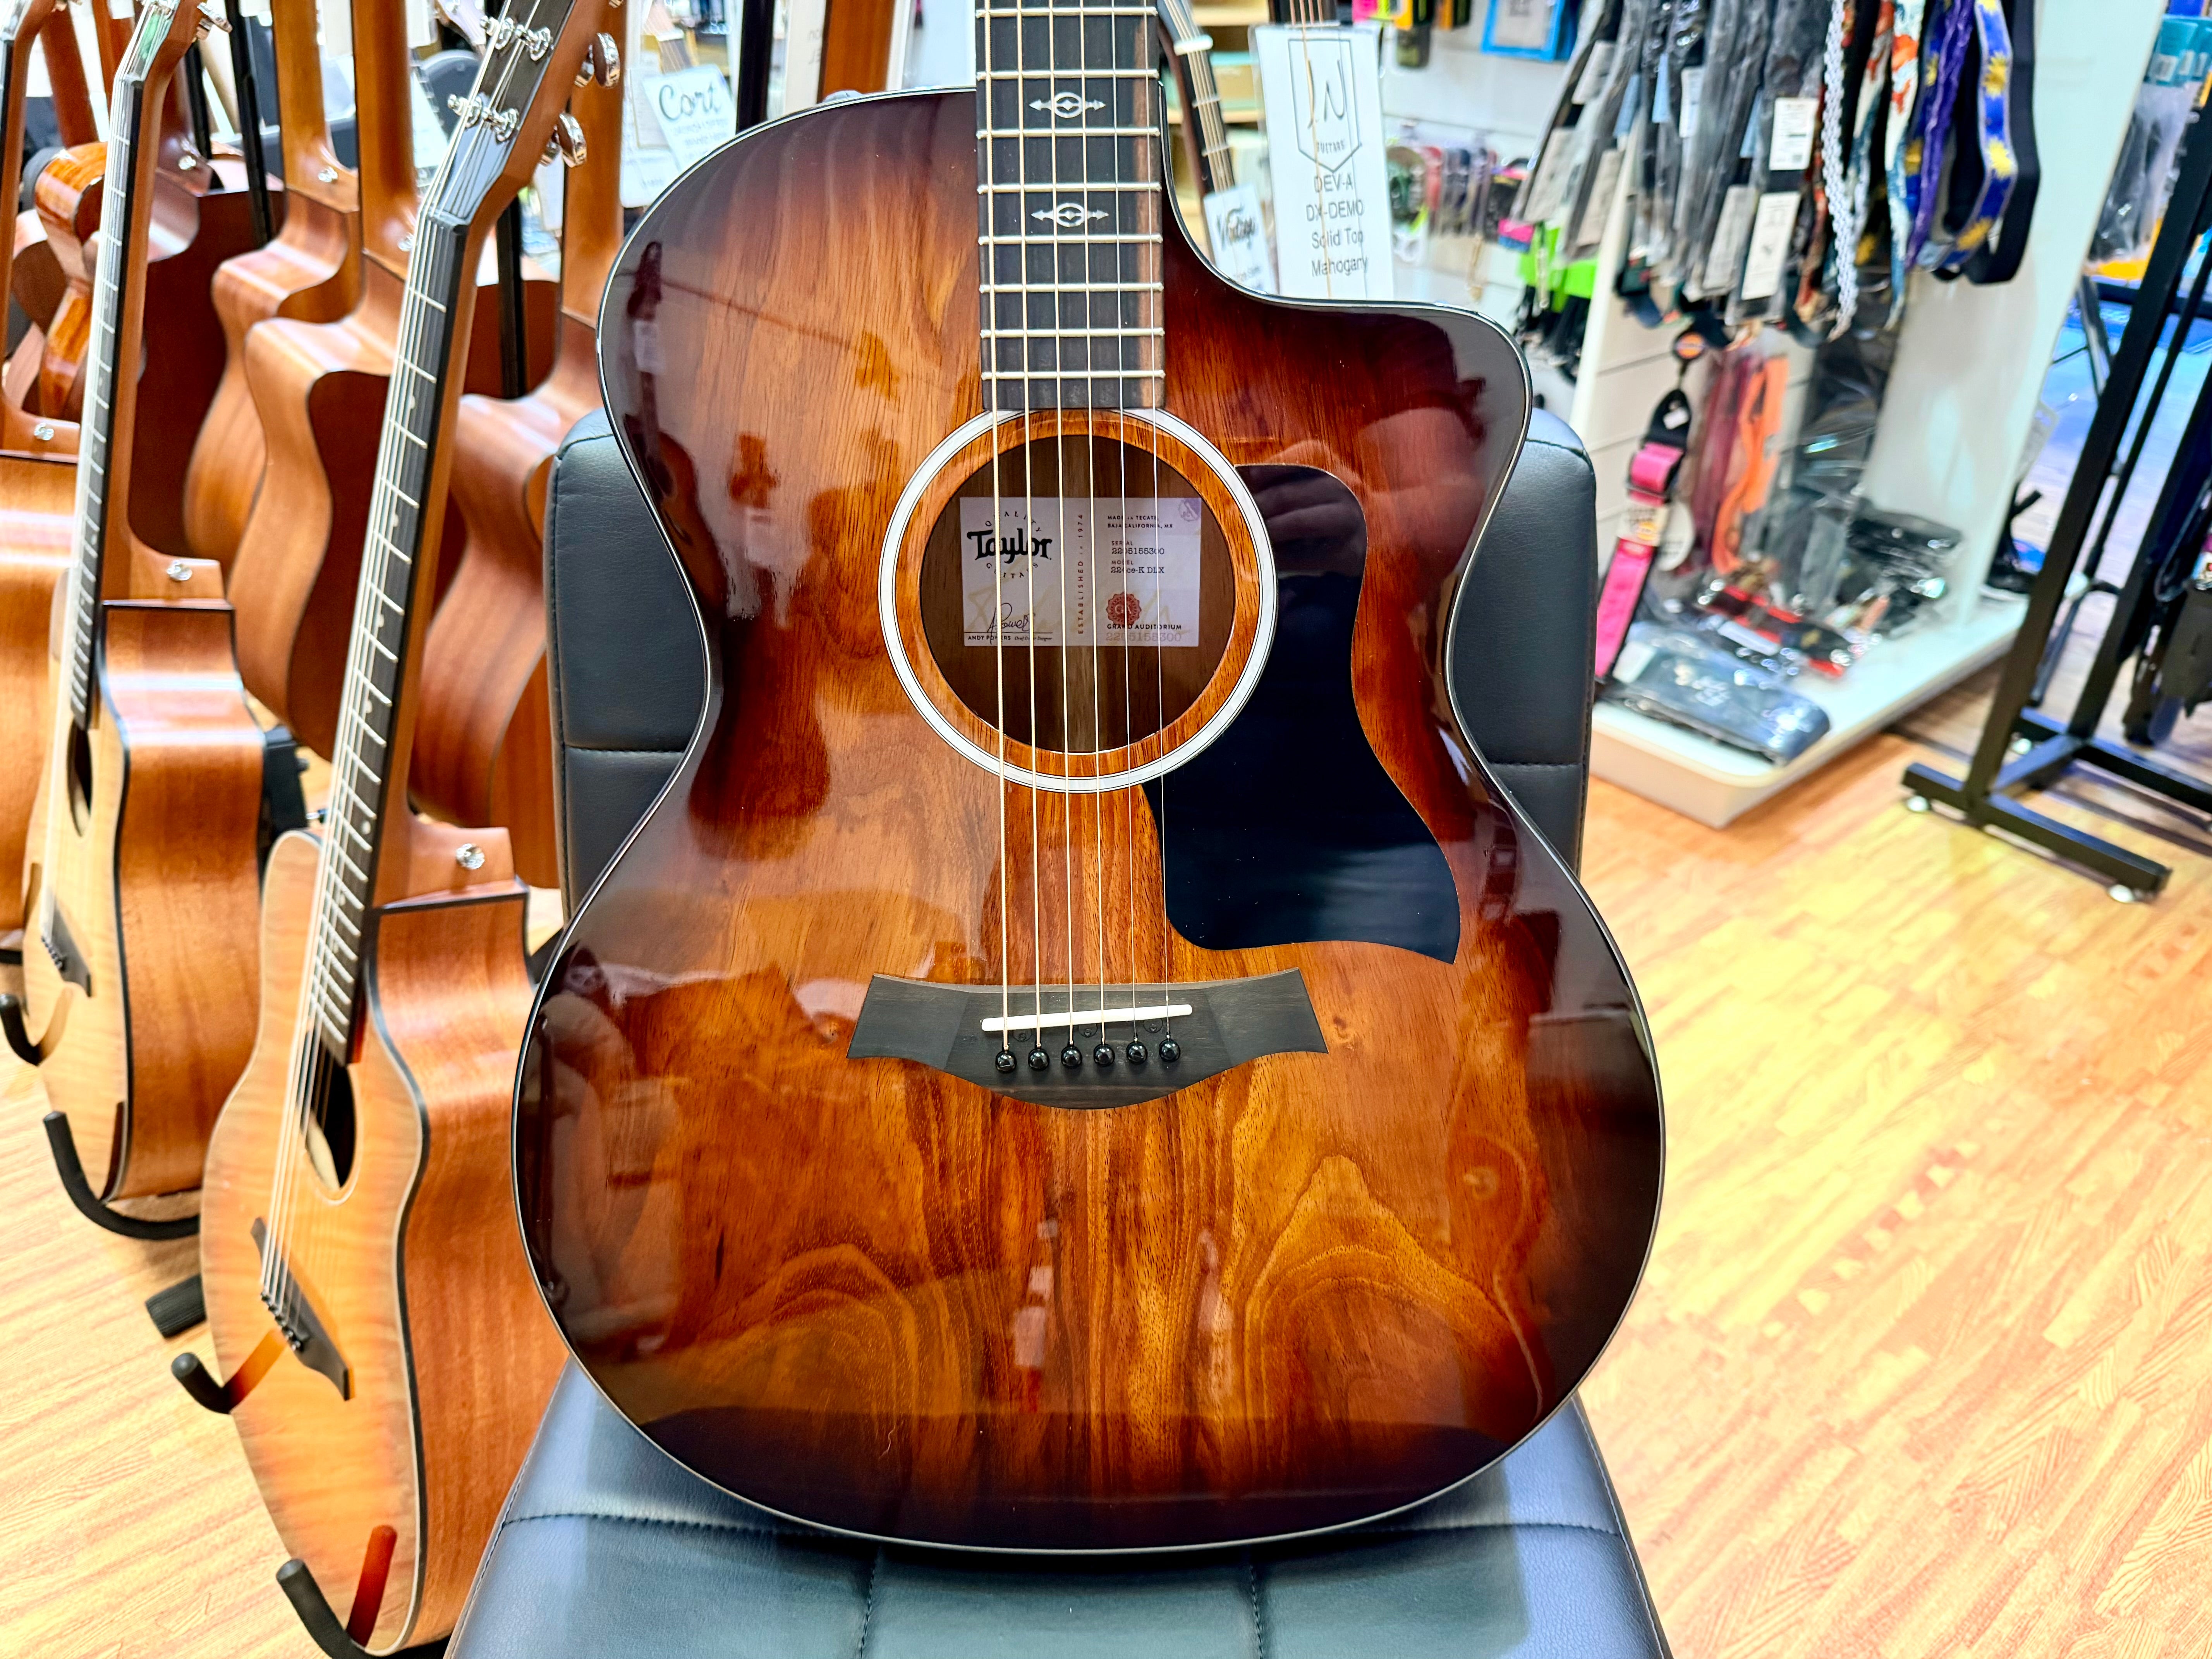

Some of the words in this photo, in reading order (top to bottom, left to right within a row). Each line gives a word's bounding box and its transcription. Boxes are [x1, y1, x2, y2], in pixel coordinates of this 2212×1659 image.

[659, 81, 722, 120] Cort
[1314, 173, 1353, 193] DEV-A
[1306, 199, 1364, 222] DX-DEMO
[1311, 228, 1341, 249] Solid
[1344, 227, 1363, 247] Top
[1311, 256, 1368, 276] Mahogany
[985, 511, 1041, 532] QALITY
[967, 528, 1053, 564] Taylor
[986, 563, 1038, 579] GITAS
